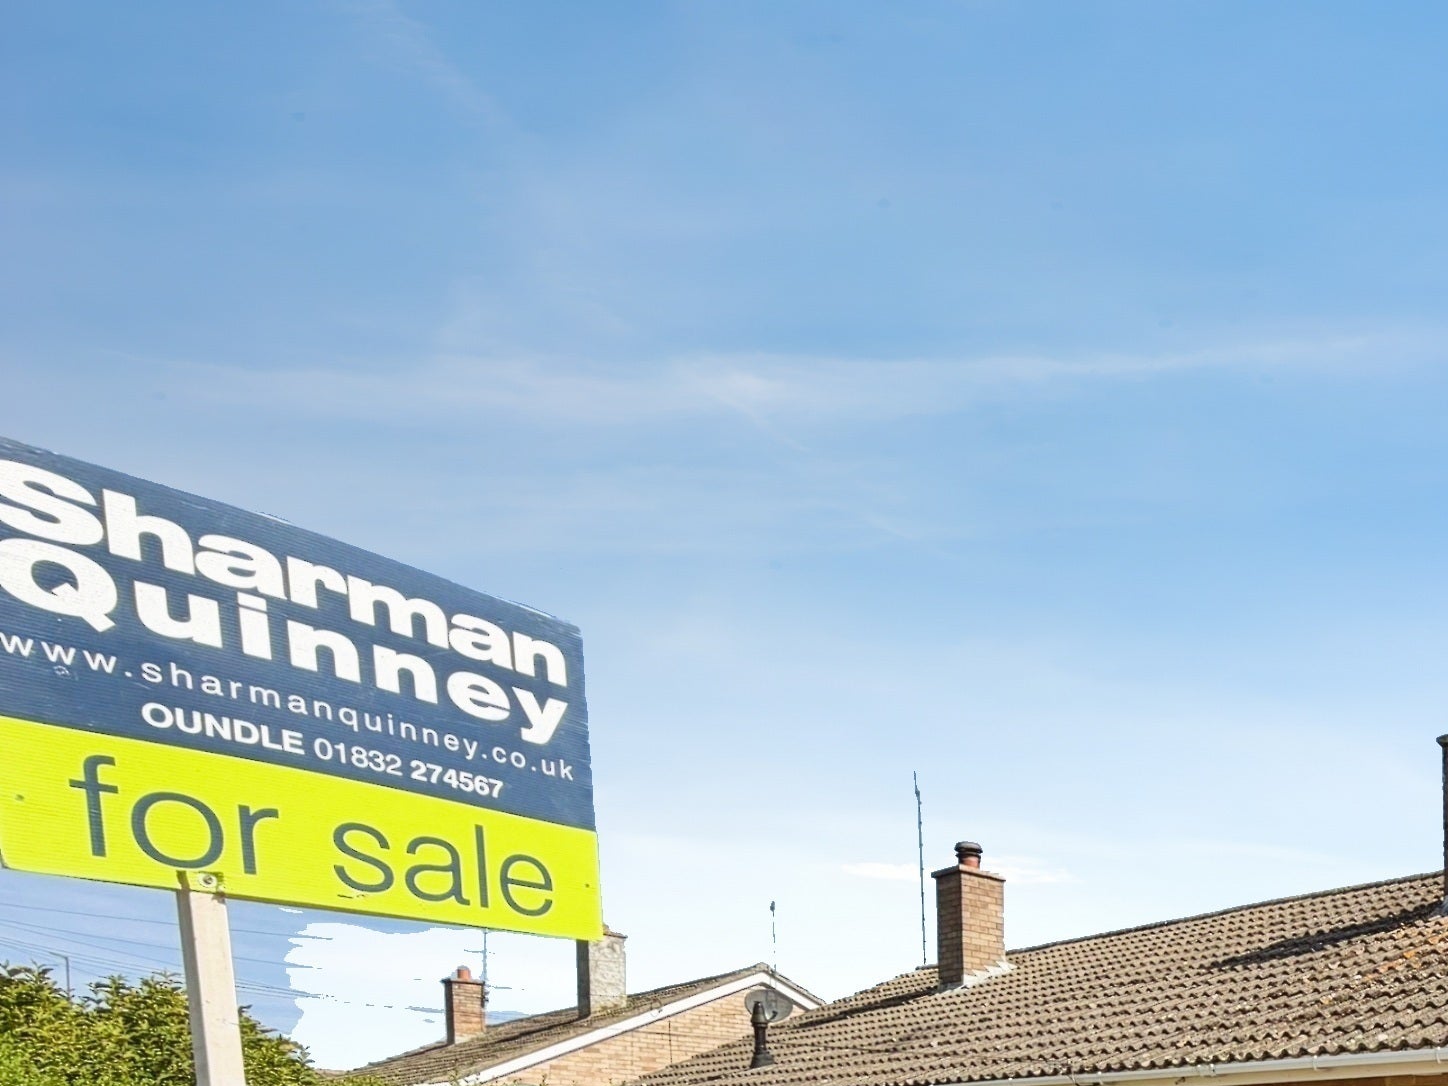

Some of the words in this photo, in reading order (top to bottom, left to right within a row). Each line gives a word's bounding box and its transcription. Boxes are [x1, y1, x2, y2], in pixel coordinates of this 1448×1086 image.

[0, 459, 567, 687] Sharman
[0, 538, 568, 744] Quinney
[0, 631, 574, 781] www.sharmanquinney.co.uk
[141, 702, 305, 755] OUNDLE
[313, 737, 402, 776] 01832
[410, 759, 503, 798] 274567
[68, 755, 279, 874] for
[332, 822, 554, 917] sale
